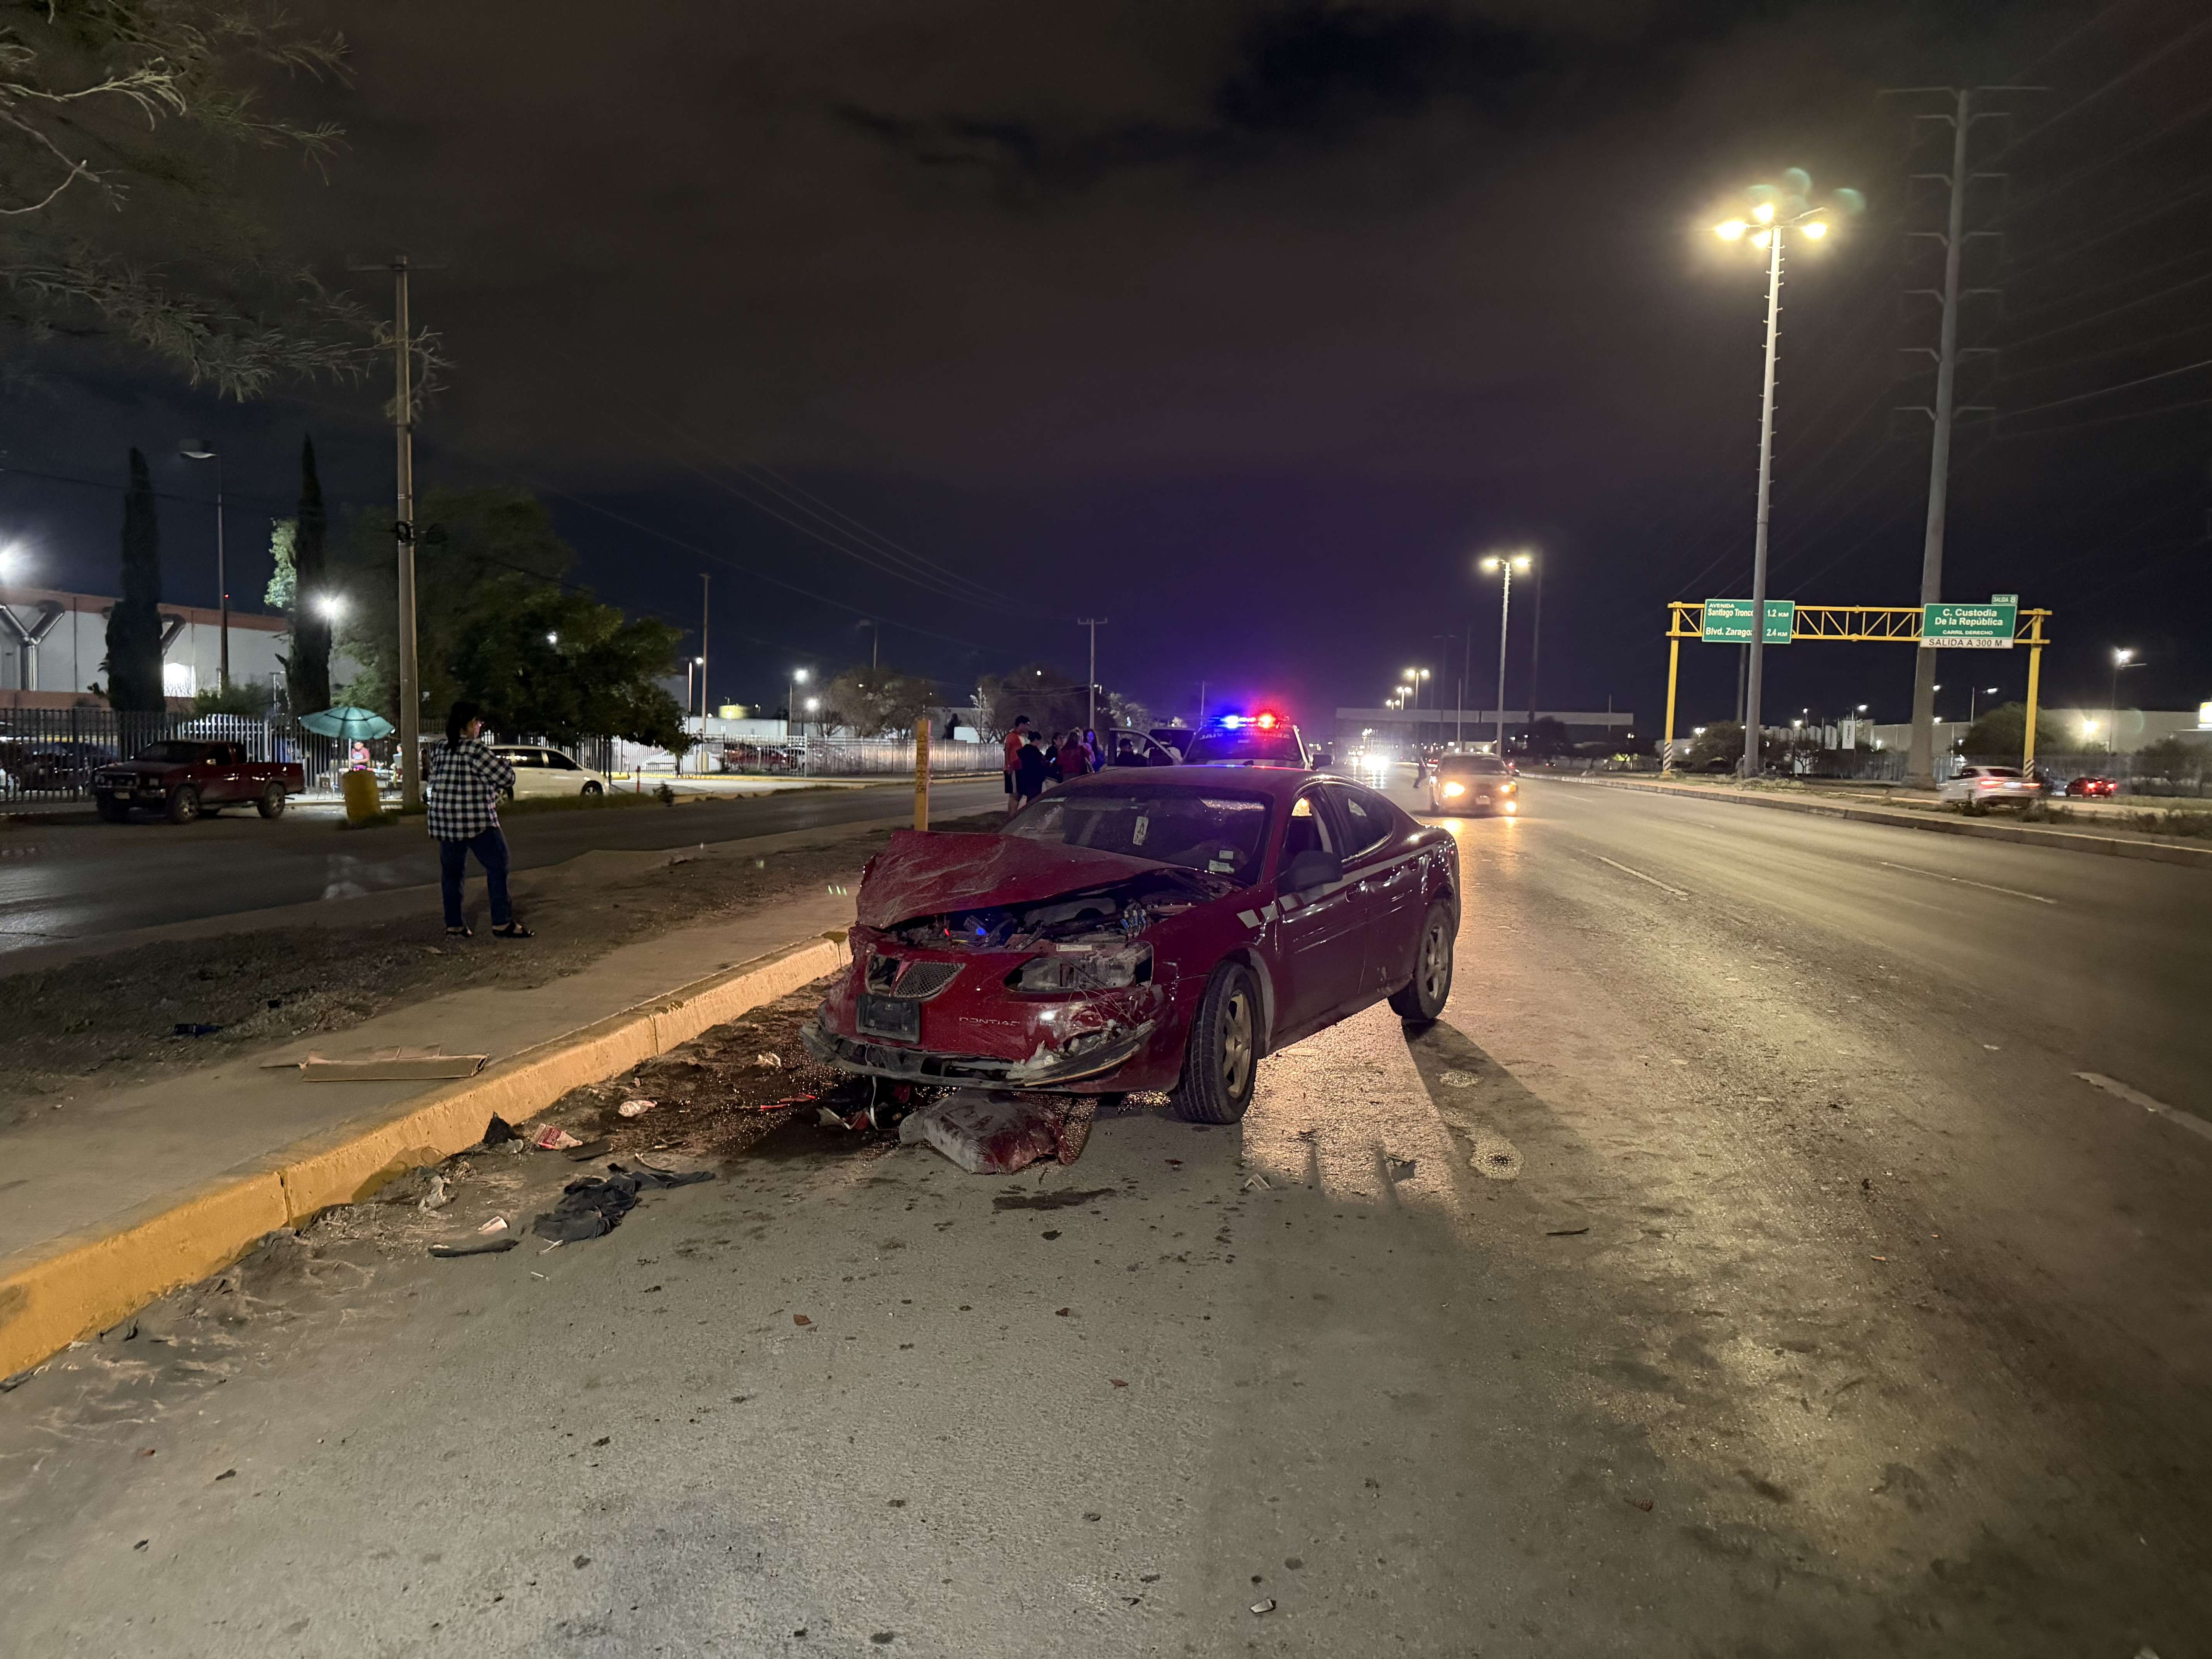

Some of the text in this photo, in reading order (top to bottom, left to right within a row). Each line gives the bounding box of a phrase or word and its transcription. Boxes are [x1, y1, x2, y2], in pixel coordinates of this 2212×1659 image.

[1707, 608, 1733, 618] Santiago
[1767, 609, 1777, 617] 1.2
[1942, 608, 1952, 617] C.
[1935, 617, 1947, 625] De
[1959, 617, 2003, 627] República
[1705, 627, 1724, 635] Blvd.
[1766, 628, 1777, 636] 2.4
[959, 1017, 1020, 1026] PONTIAC
